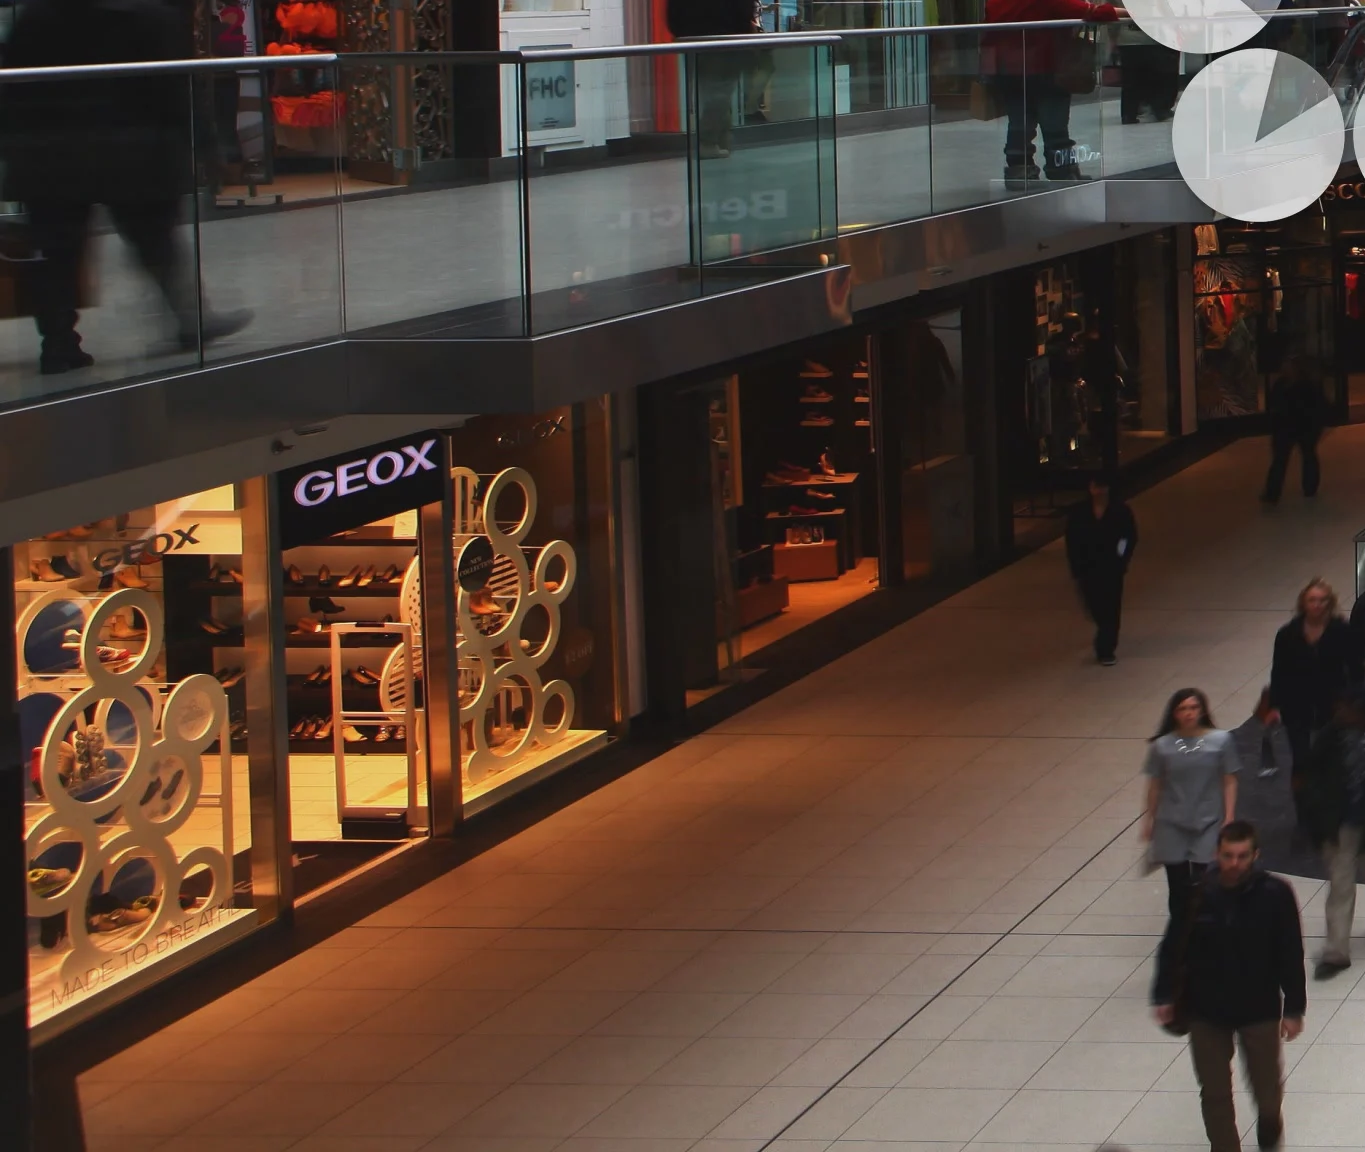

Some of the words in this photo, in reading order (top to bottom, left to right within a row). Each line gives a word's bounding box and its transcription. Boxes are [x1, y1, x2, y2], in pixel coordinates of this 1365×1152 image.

[529, 75, 567, 101] FHC
[292, 438, 438, 509] GEOX
[93, 522, 200, 572] GEOX
[51, 959, 115, 1009] MADE
[121, 943, 149, 970] TO
